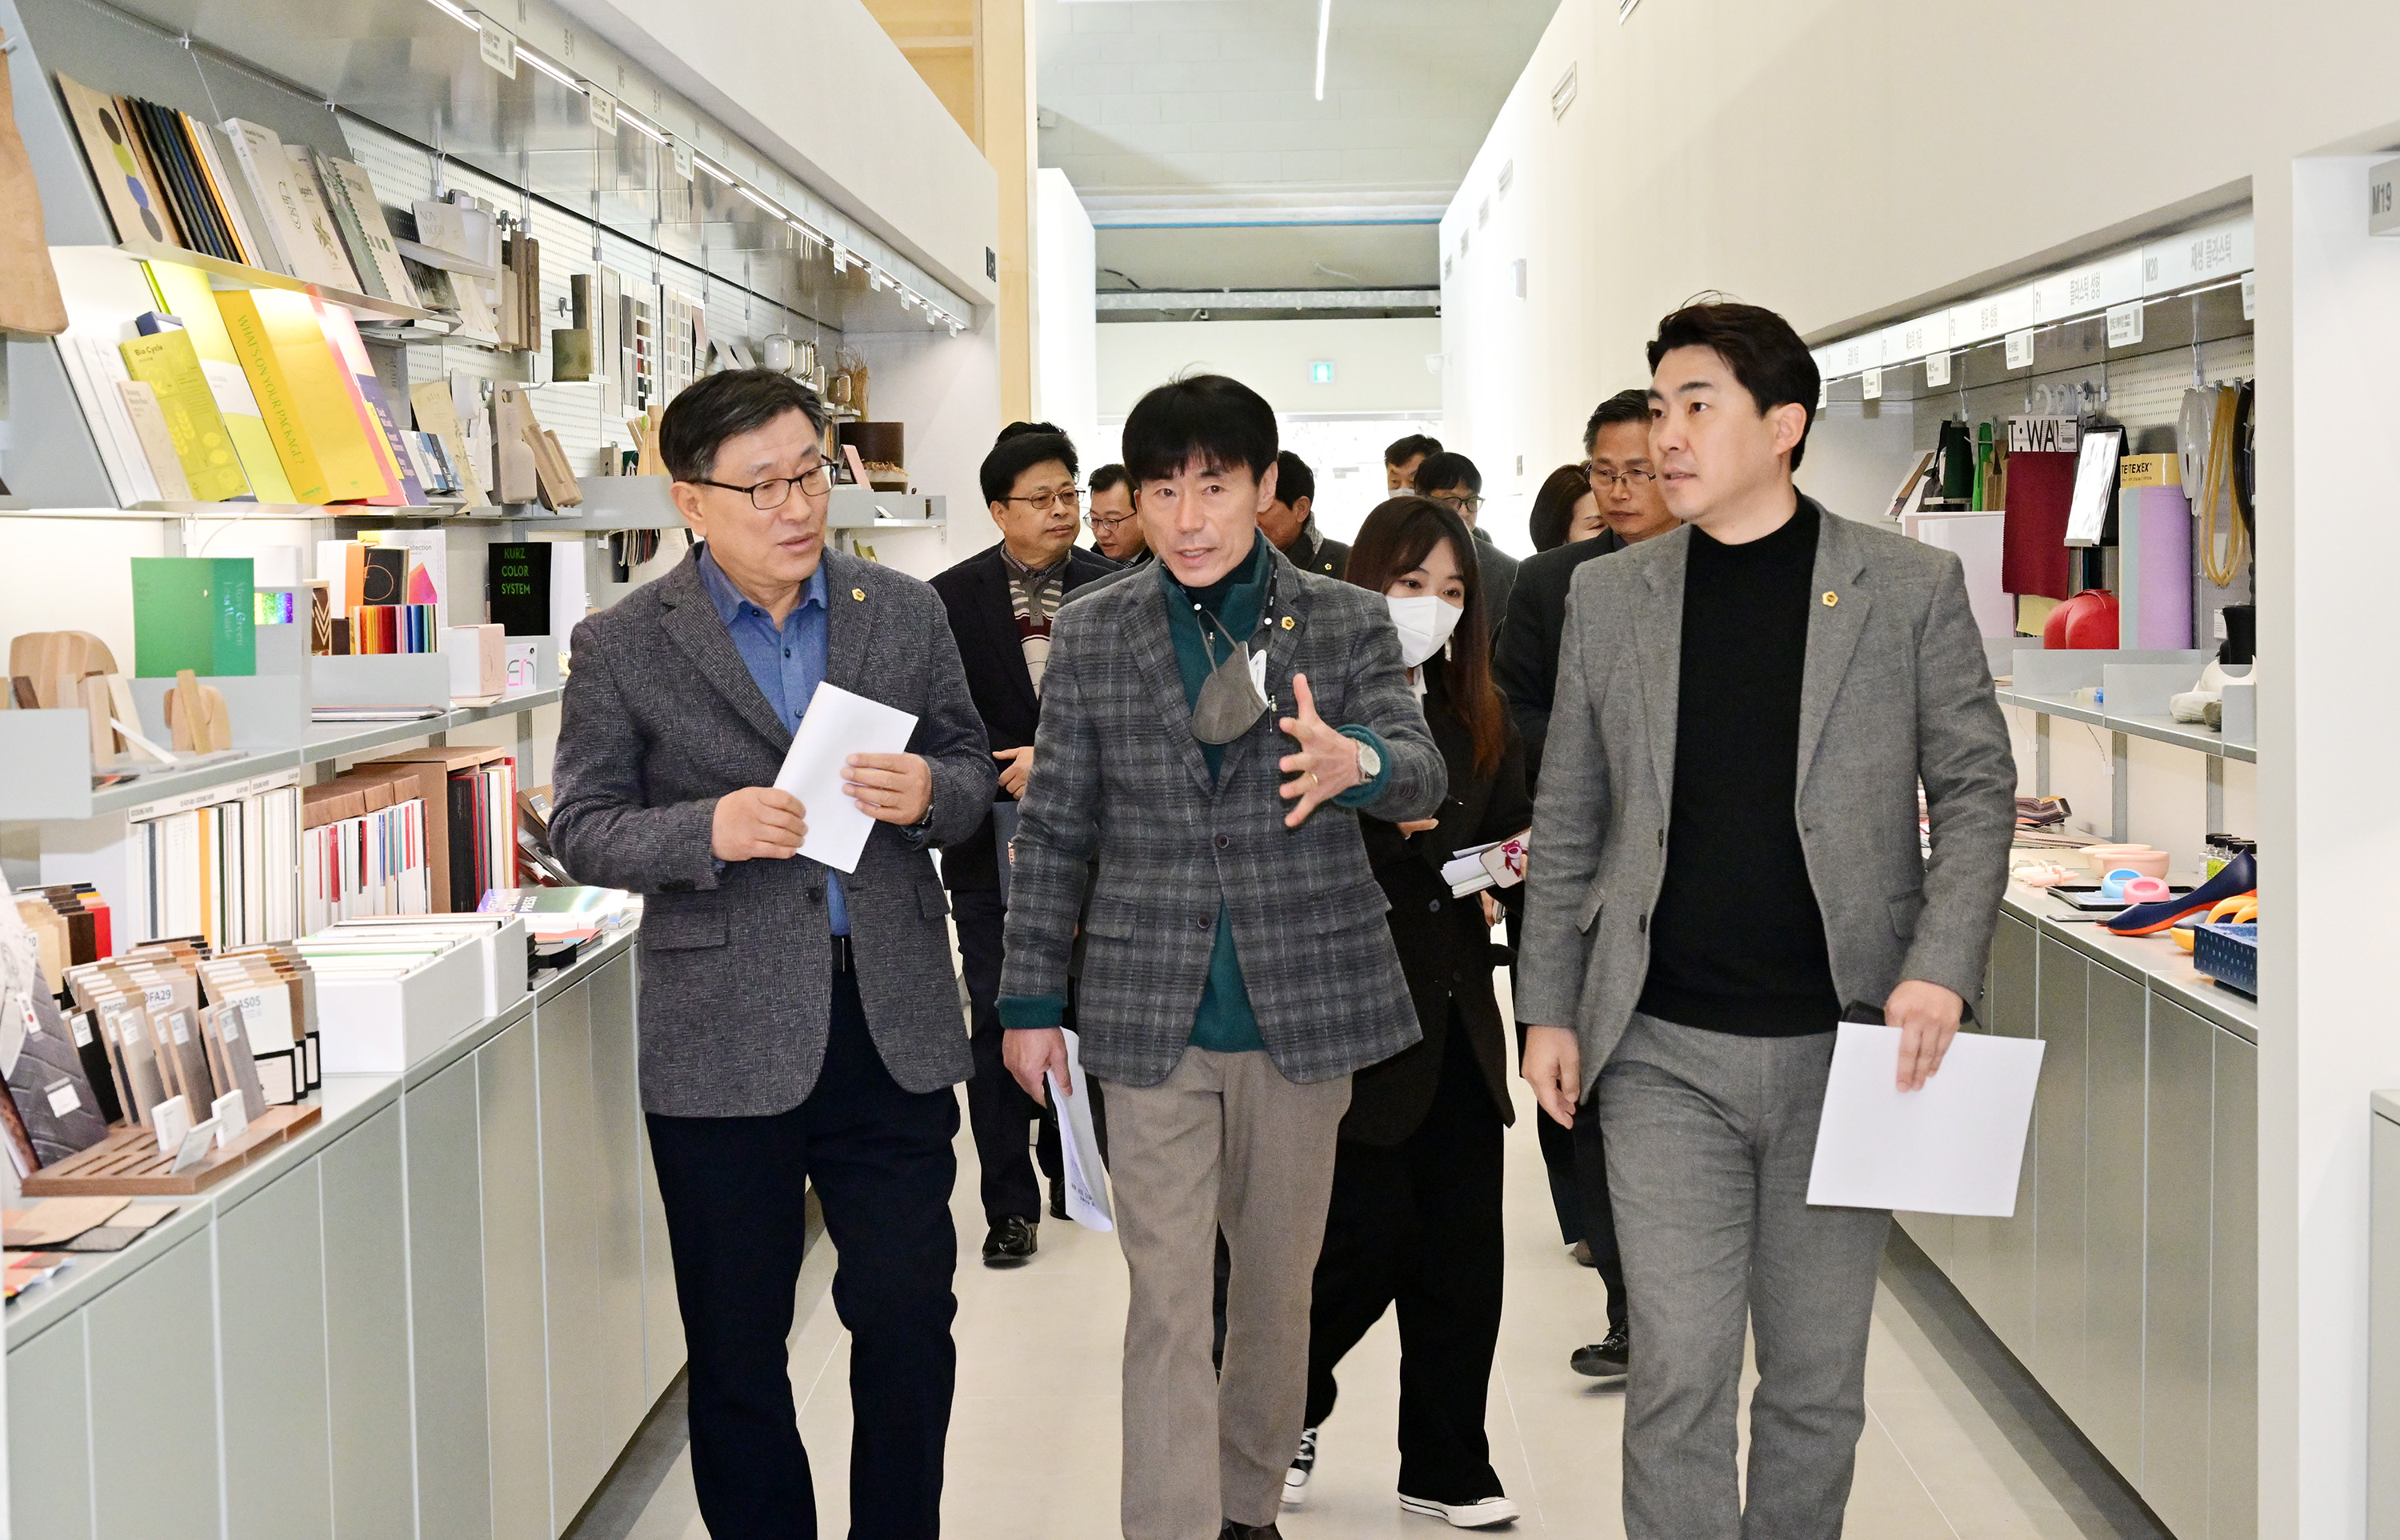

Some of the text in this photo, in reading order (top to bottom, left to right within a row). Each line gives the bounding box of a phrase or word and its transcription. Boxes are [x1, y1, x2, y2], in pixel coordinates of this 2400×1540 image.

[2372, 182, 2392, 215] M19
[2190, 232, 2232, 272] 재생 플라스틱
[2145, 257, 2158, 282] M20
[2070, 271, 2101, 306] 플라스틱 성형
[134, 344, 163, 357] Bio Cycle
[238, 314, 306, 464] WHAT'S ON YOUR PACKAGE?
[504, 547, 526, 559] KURZ
[502, 565, 529, 577] COLOR
[502, 582, 530, 594] SYSTEM
[519, 896, 538, 912] PRESS
